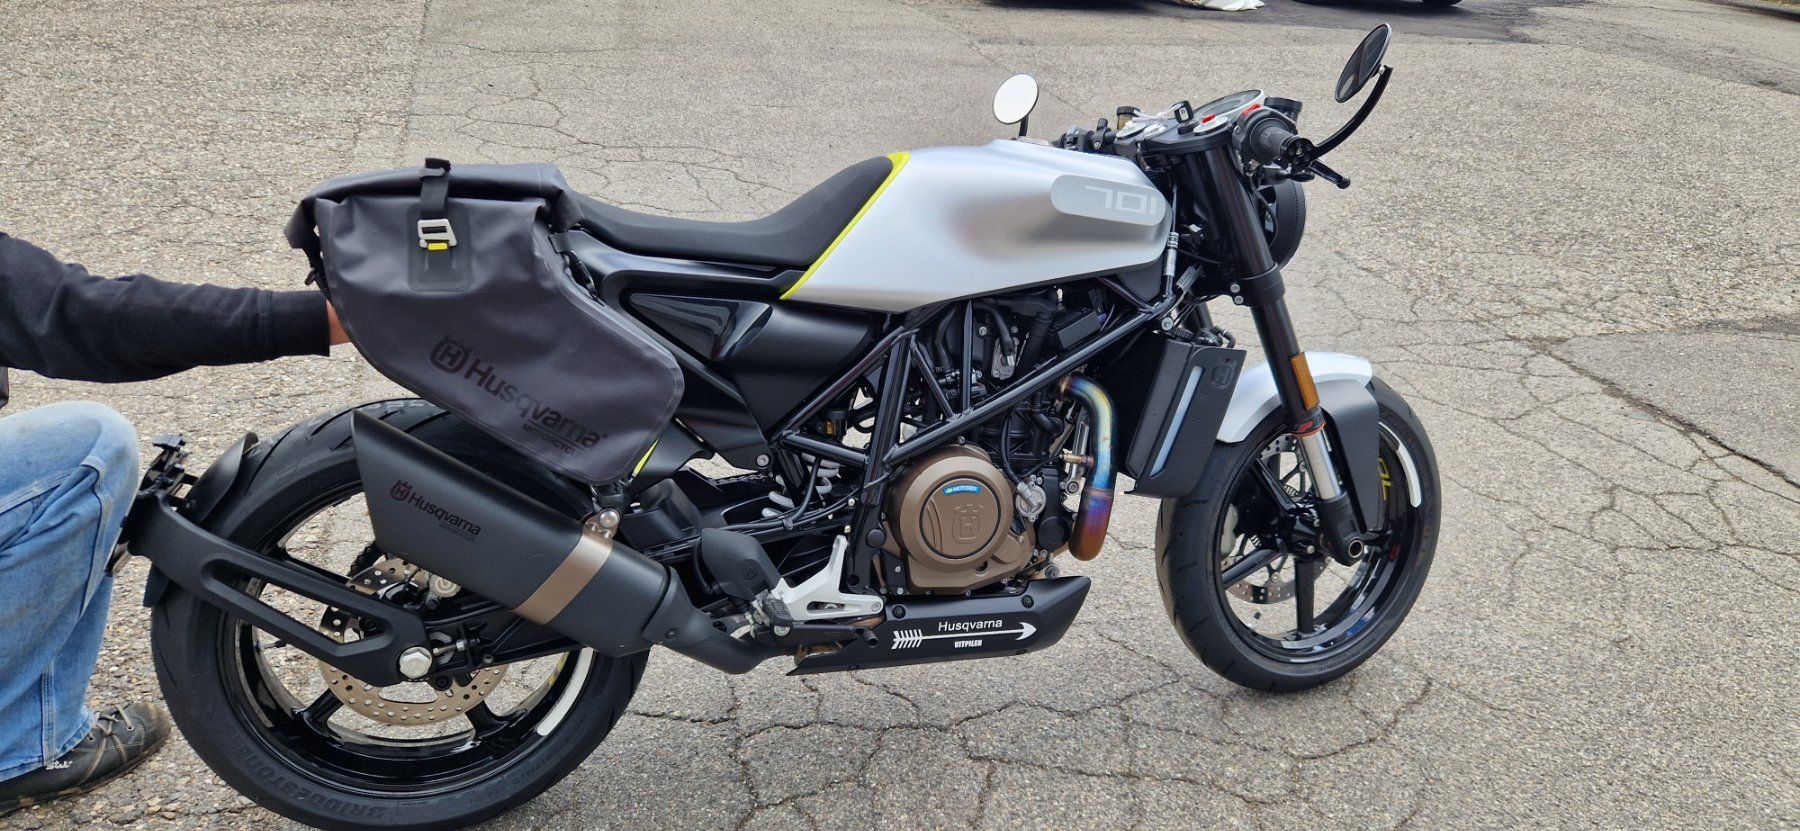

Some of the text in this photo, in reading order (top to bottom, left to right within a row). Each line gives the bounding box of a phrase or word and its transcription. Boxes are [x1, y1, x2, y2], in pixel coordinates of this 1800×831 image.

[1084, 185, 1157, 215] 701
[463, 358, 600, 448] Husqvarna
[521, 423, 588, 460] MOTORCYCL
[407, 492, 481, 536] Husqvarna
[938, 619, 1003, 632] Husqvarna
[954, 639, 983, 648] VITPILEN
